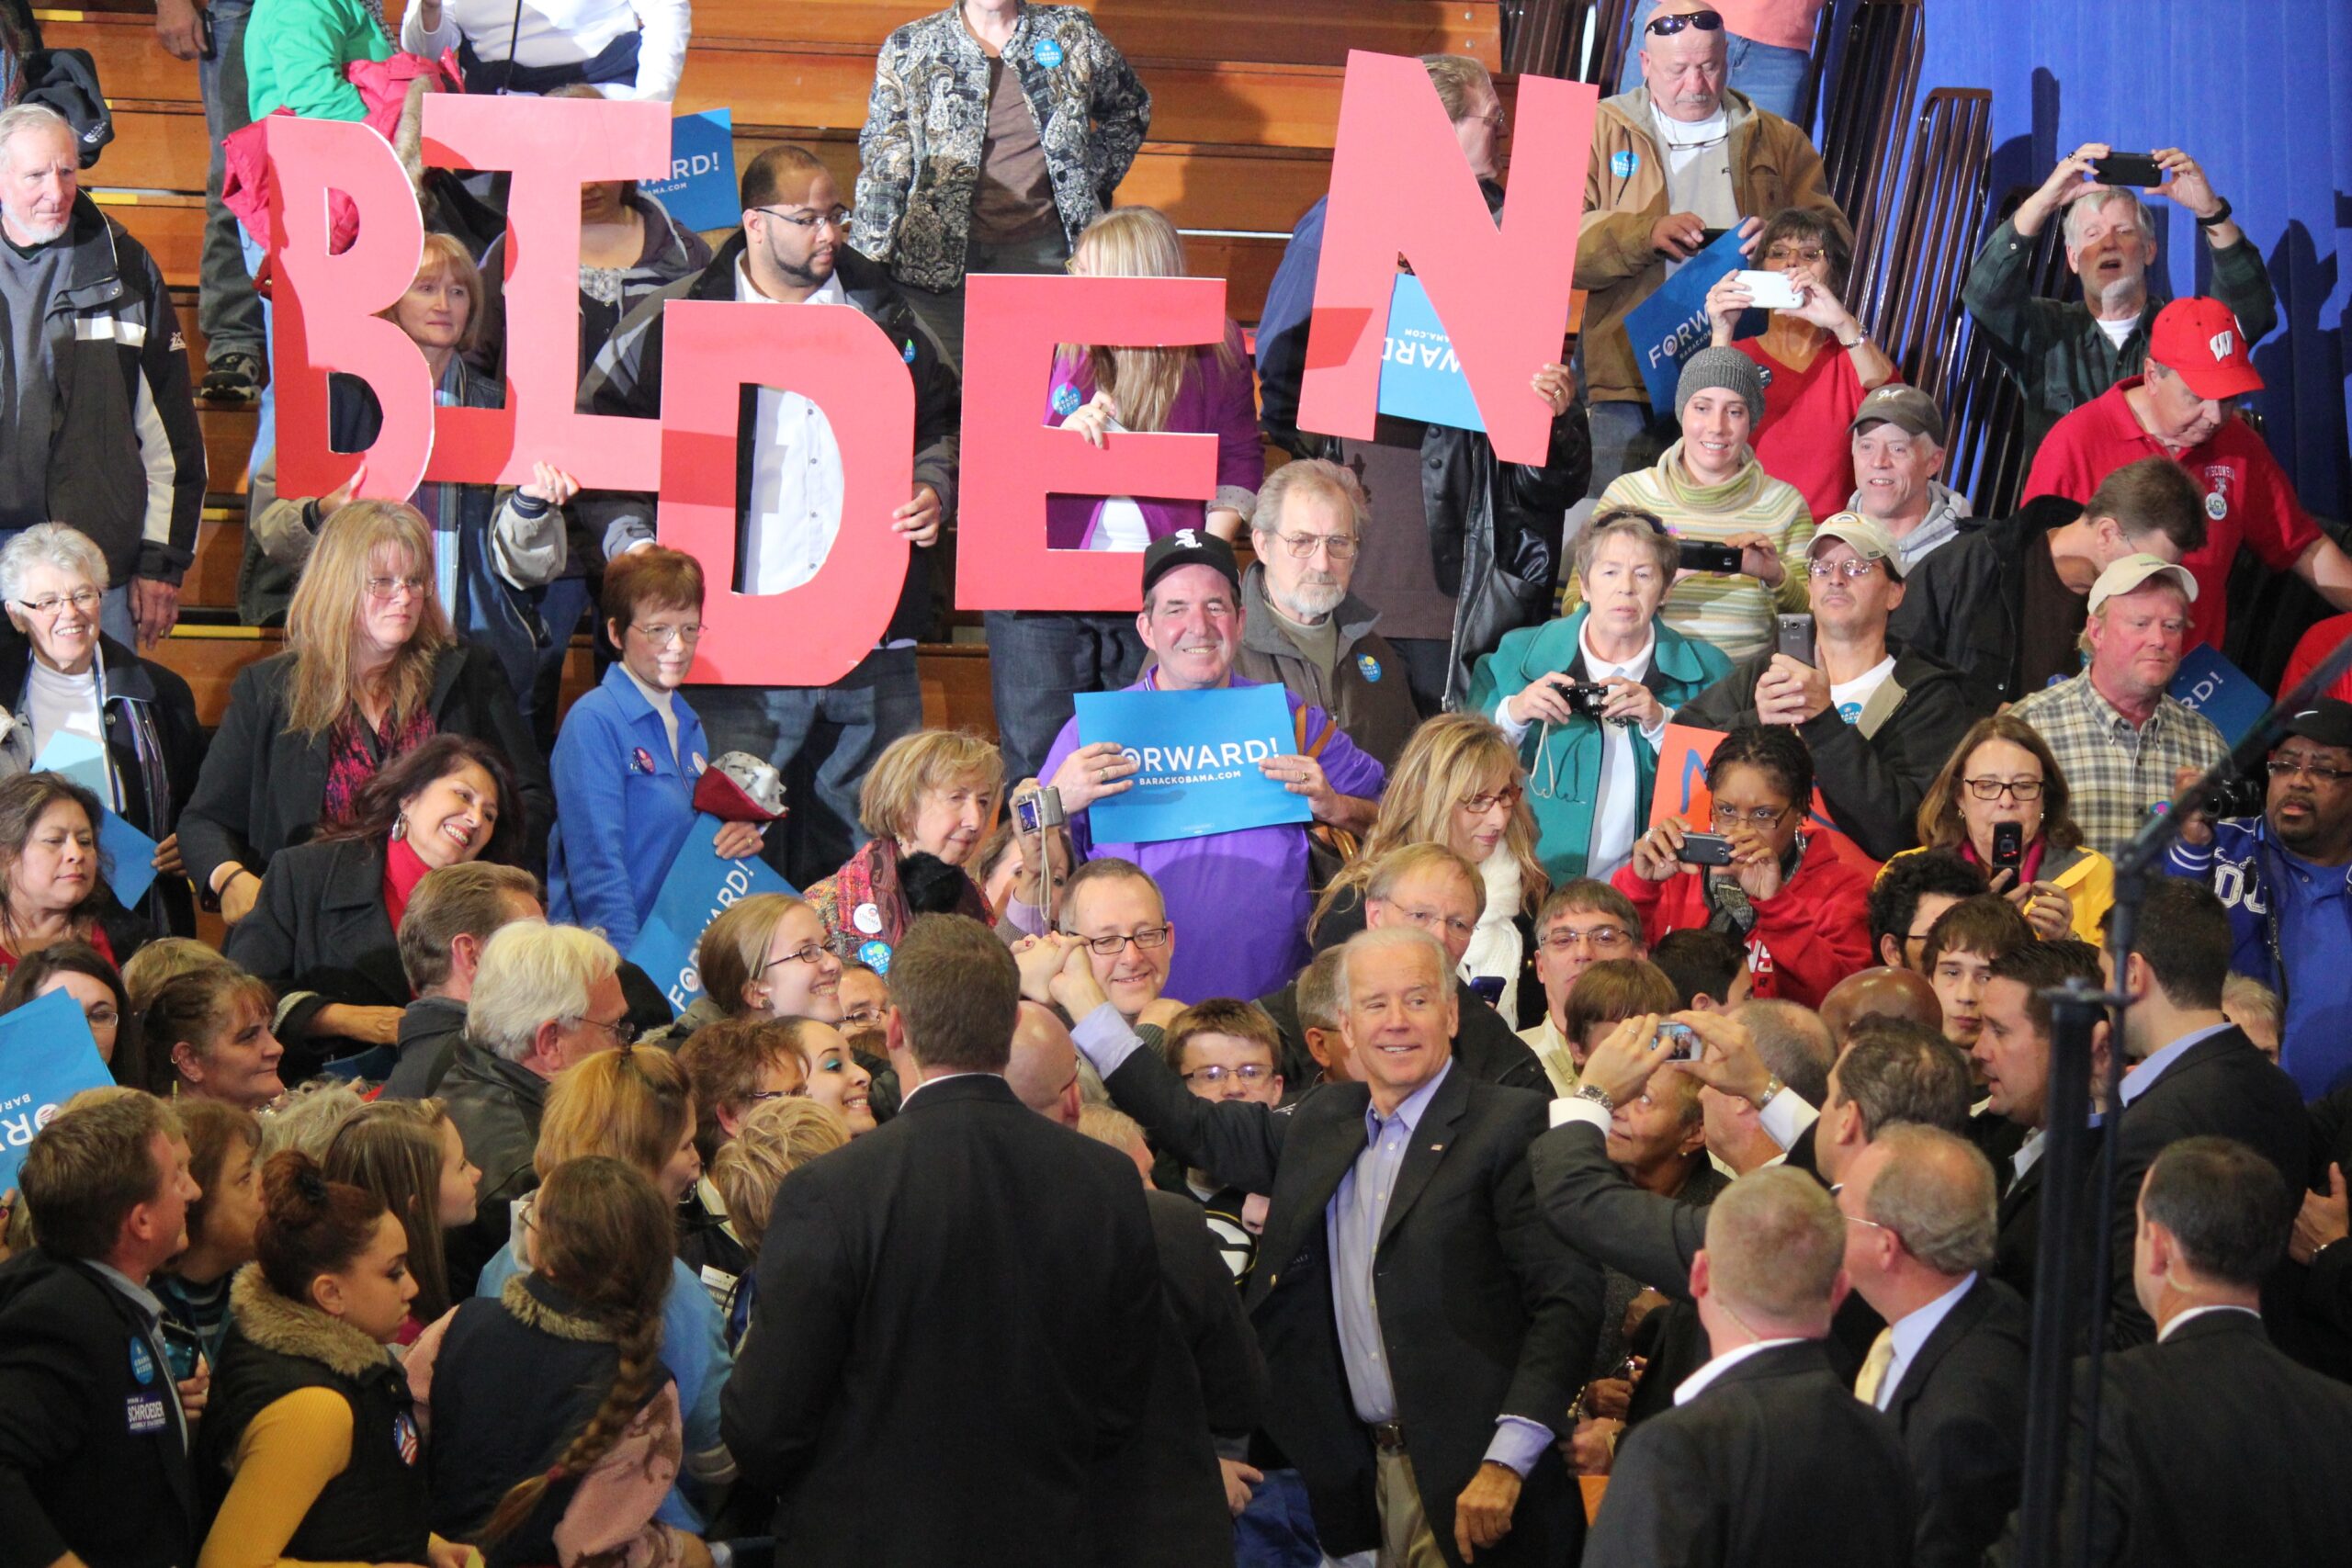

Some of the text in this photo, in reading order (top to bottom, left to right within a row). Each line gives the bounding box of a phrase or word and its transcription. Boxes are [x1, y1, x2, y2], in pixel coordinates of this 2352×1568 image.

[2209, 330, 2233, 363] W
[1120, 737, 1280, 773] ORWARD!
[1138, 770, 1241, 786] BARACKOBAMA.COM
[127, 1401, 164, 1423] SCHROEDER
